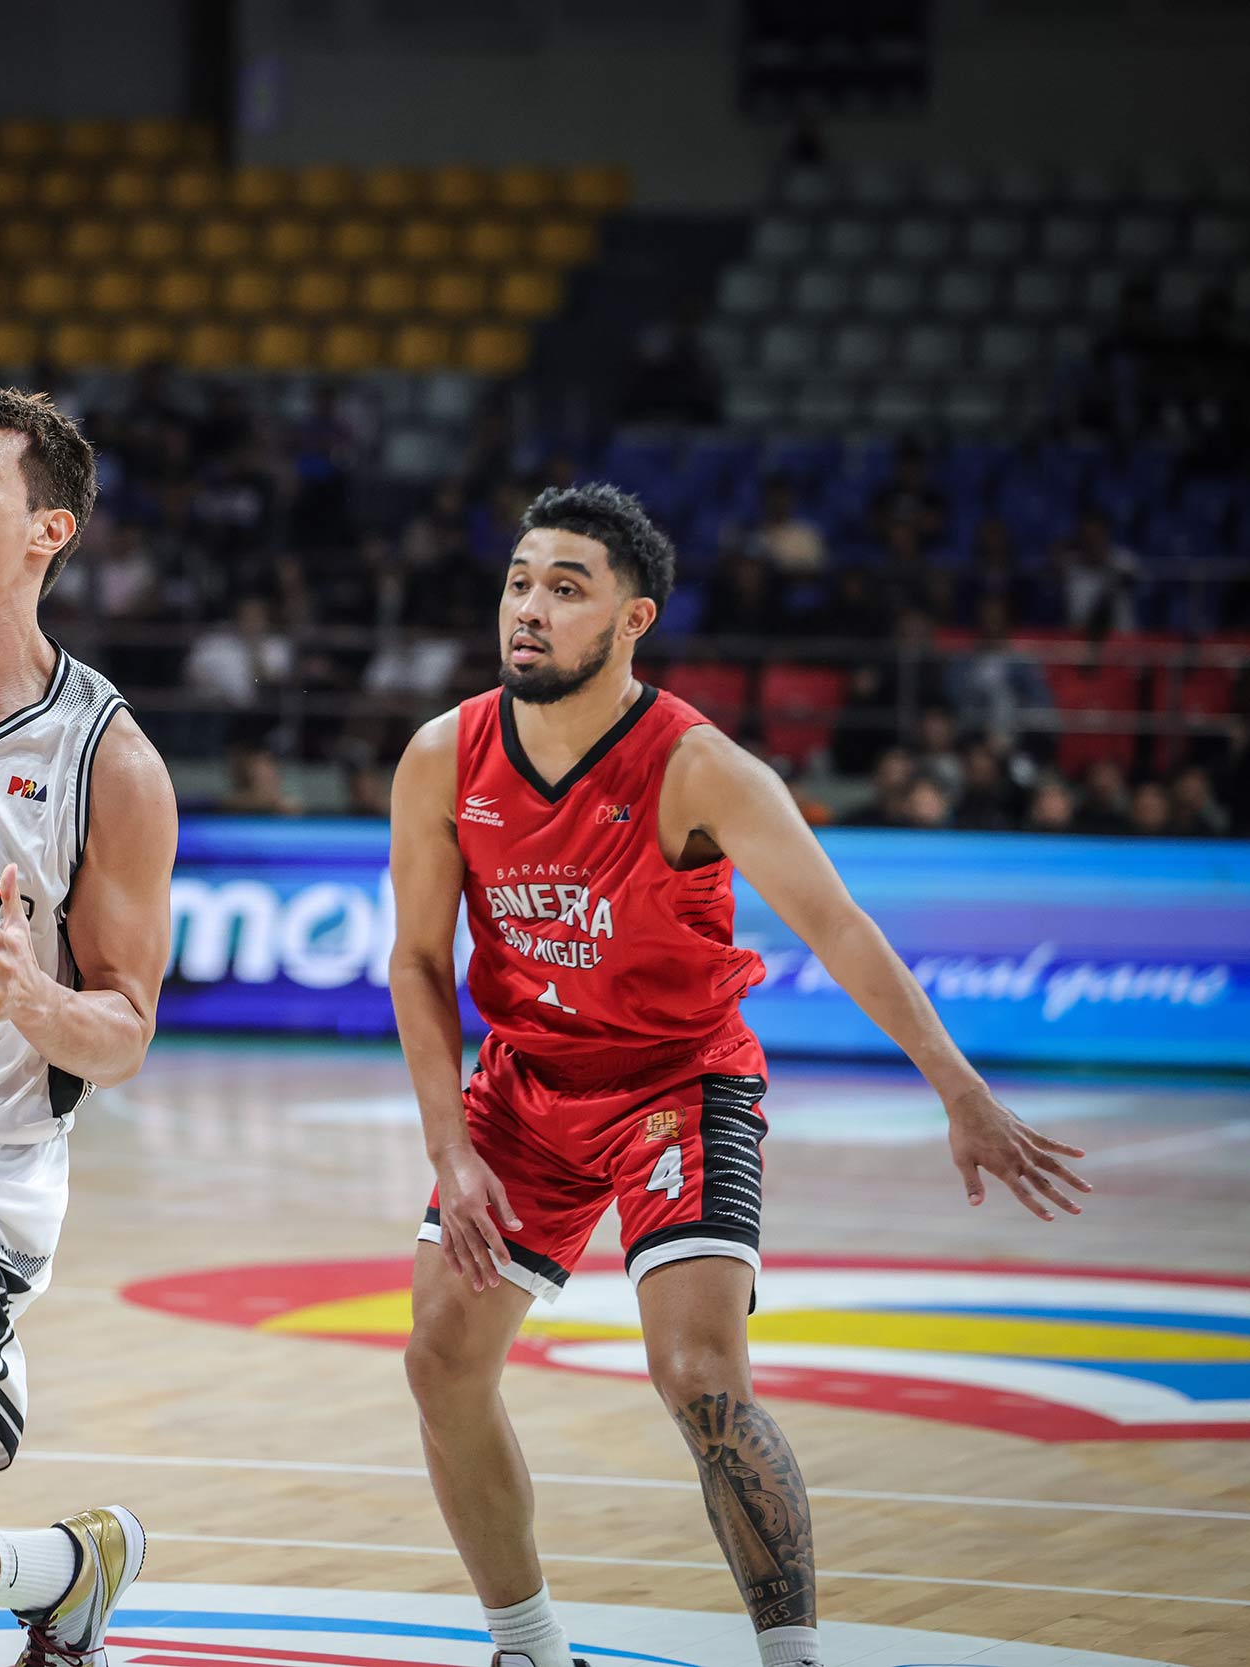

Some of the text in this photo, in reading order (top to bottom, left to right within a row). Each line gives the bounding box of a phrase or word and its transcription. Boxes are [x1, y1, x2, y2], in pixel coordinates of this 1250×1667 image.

[6, 775, 48, 803] PBA
[465, 806, 500, 820] WORLD
[496, 863, 592, 880] BARANGA
[645, 1144, 684, 1200] 4
[768, 1579, 790, 1595] TO
